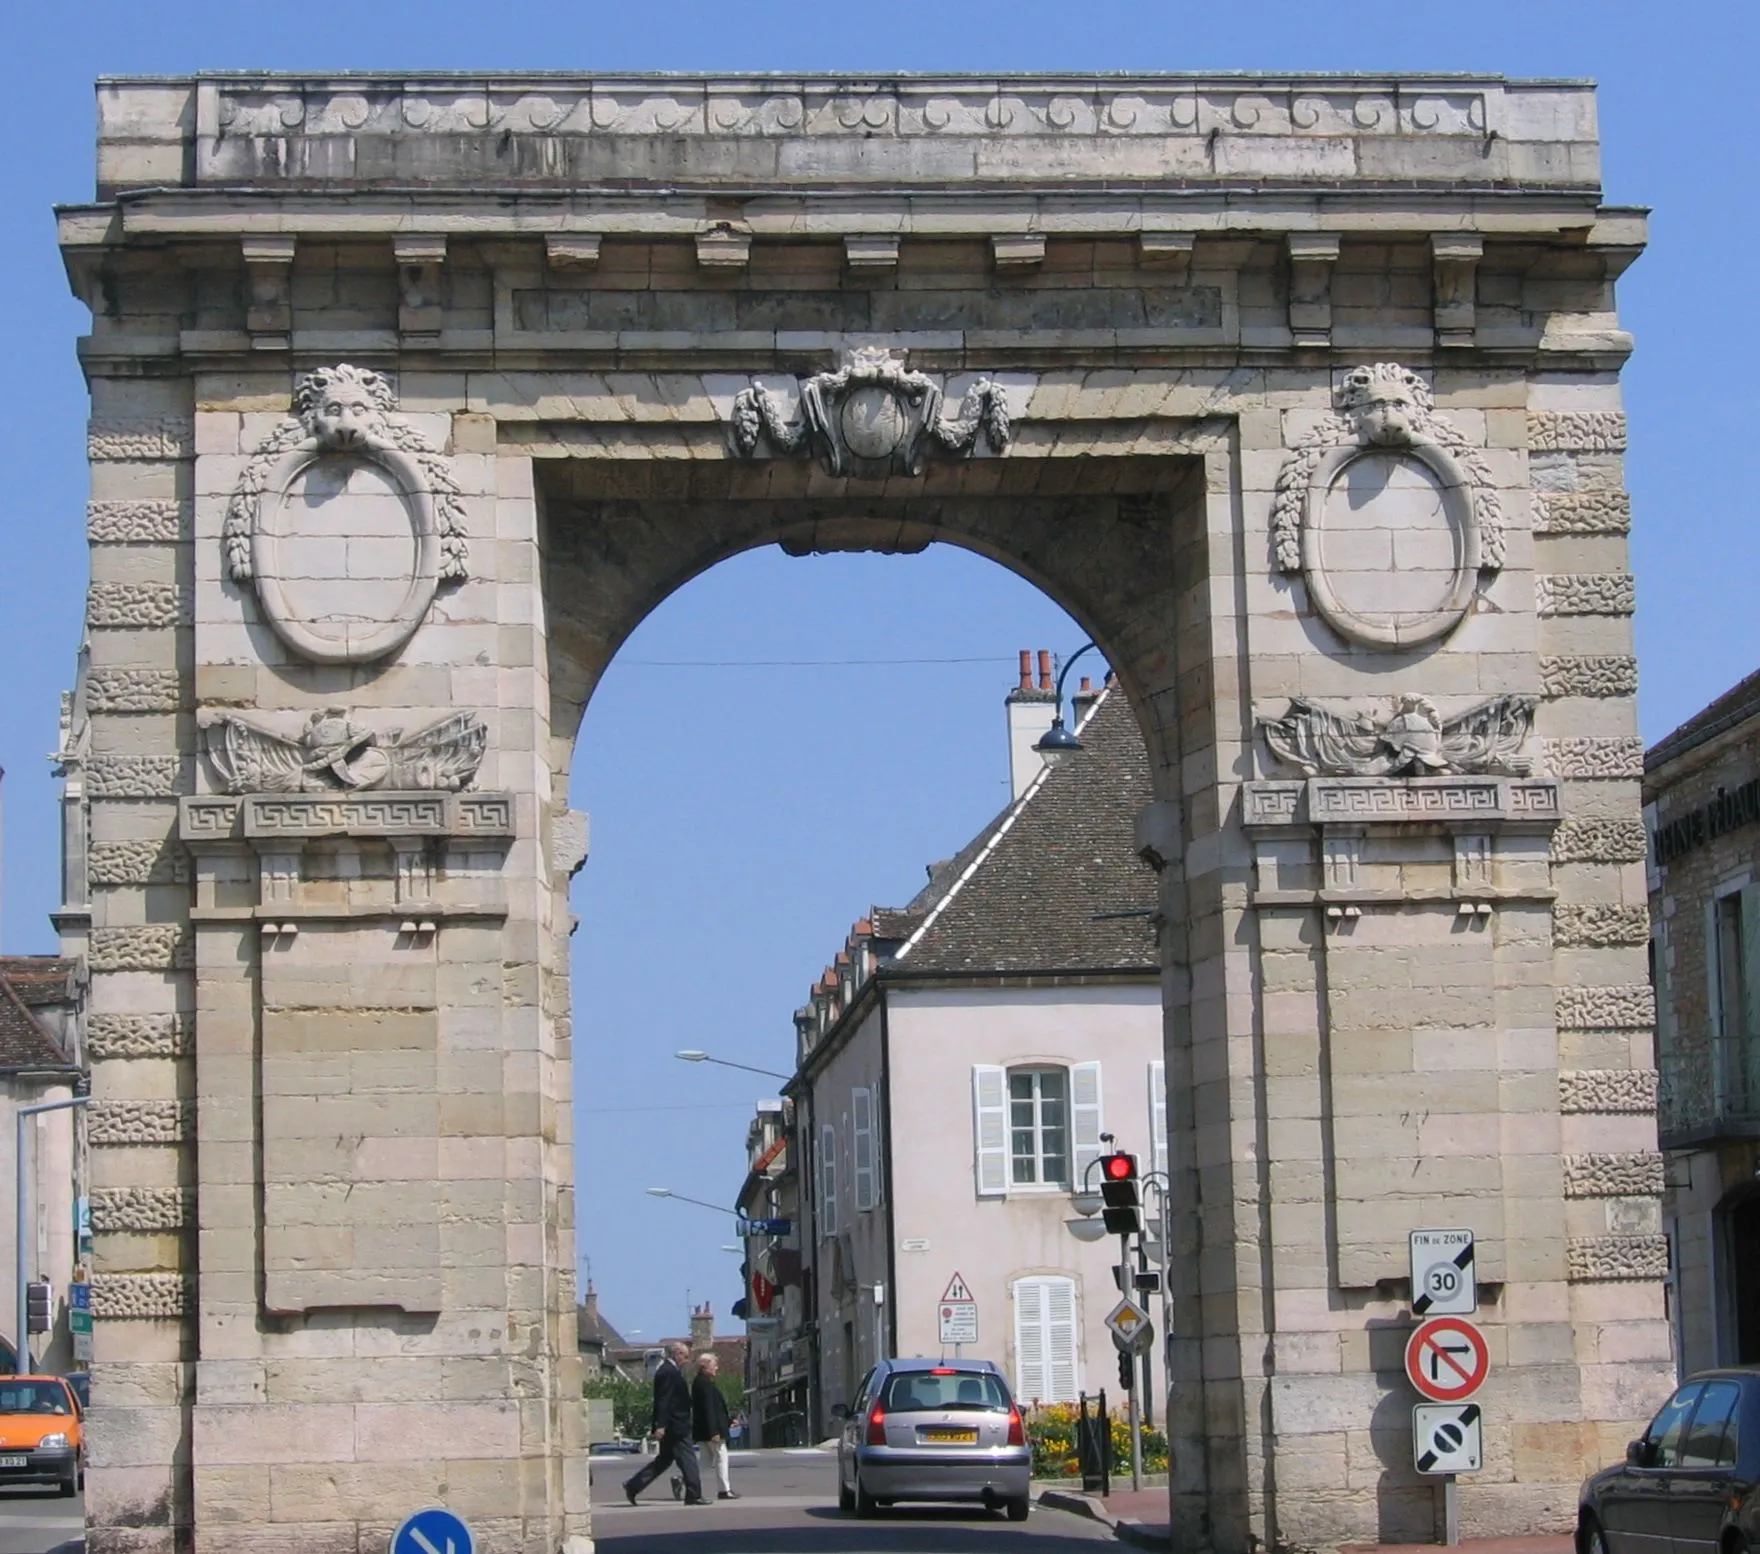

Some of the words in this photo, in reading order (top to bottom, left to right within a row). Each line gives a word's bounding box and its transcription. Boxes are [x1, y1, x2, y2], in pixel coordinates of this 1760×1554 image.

[1414, 1235, 1430, 1245] FIN
[1443, 1234, 1469, 1245] ZONE
[1431, 1273, 1456, 1291] 30
